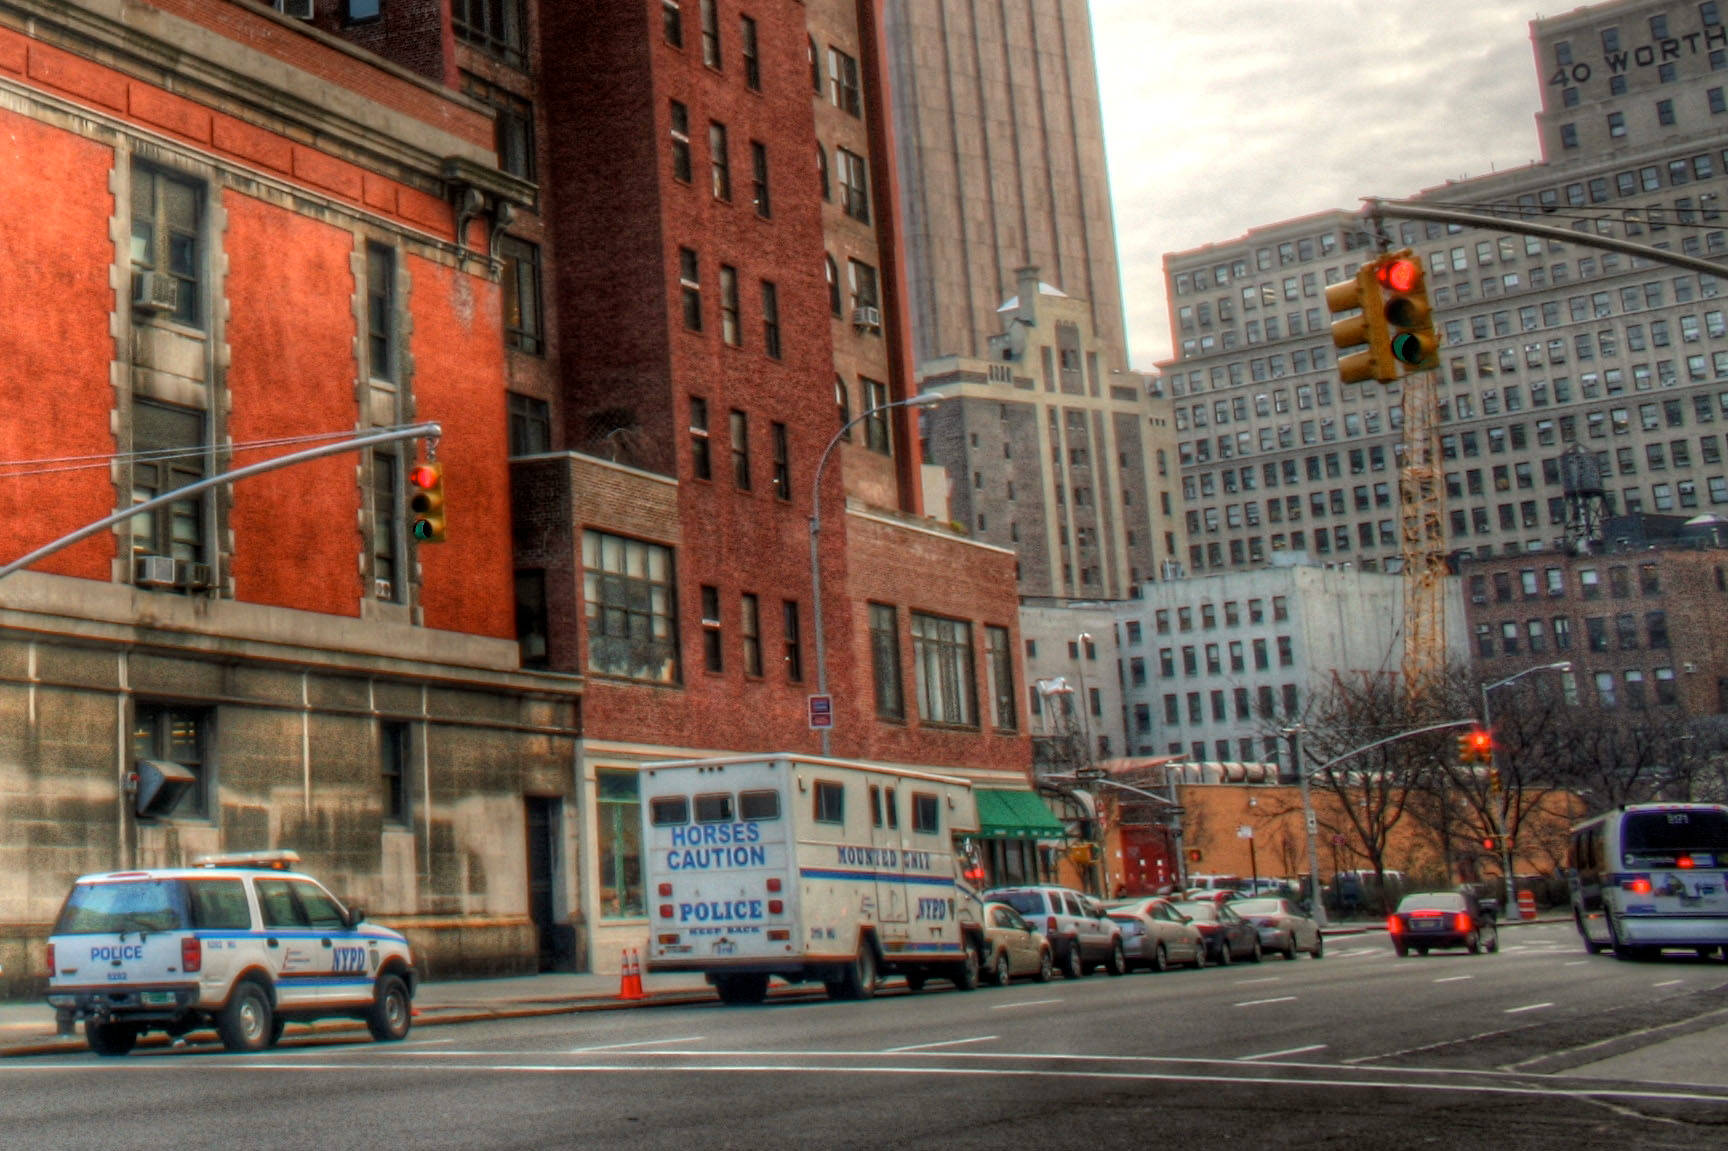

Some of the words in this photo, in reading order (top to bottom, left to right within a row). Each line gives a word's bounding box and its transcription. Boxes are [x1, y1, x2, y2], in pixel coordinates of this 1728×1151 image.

[1549, 63, 1591, 87] 40
[1604, 26, 1728, 74] WORTH
[672, 822, 760, 846] HORSES
[666, 846, 765, 870] CAUTION
[837, 845, 897, 868] MOUNTED
[902, 850, 930, 871] UNIT
[679, 900, 763, 922] POLICE
[918, 897, 946, 921] NYPD
[91, 945, 143, 960] POLICE
[332, 947, 366, 972] NYPD
